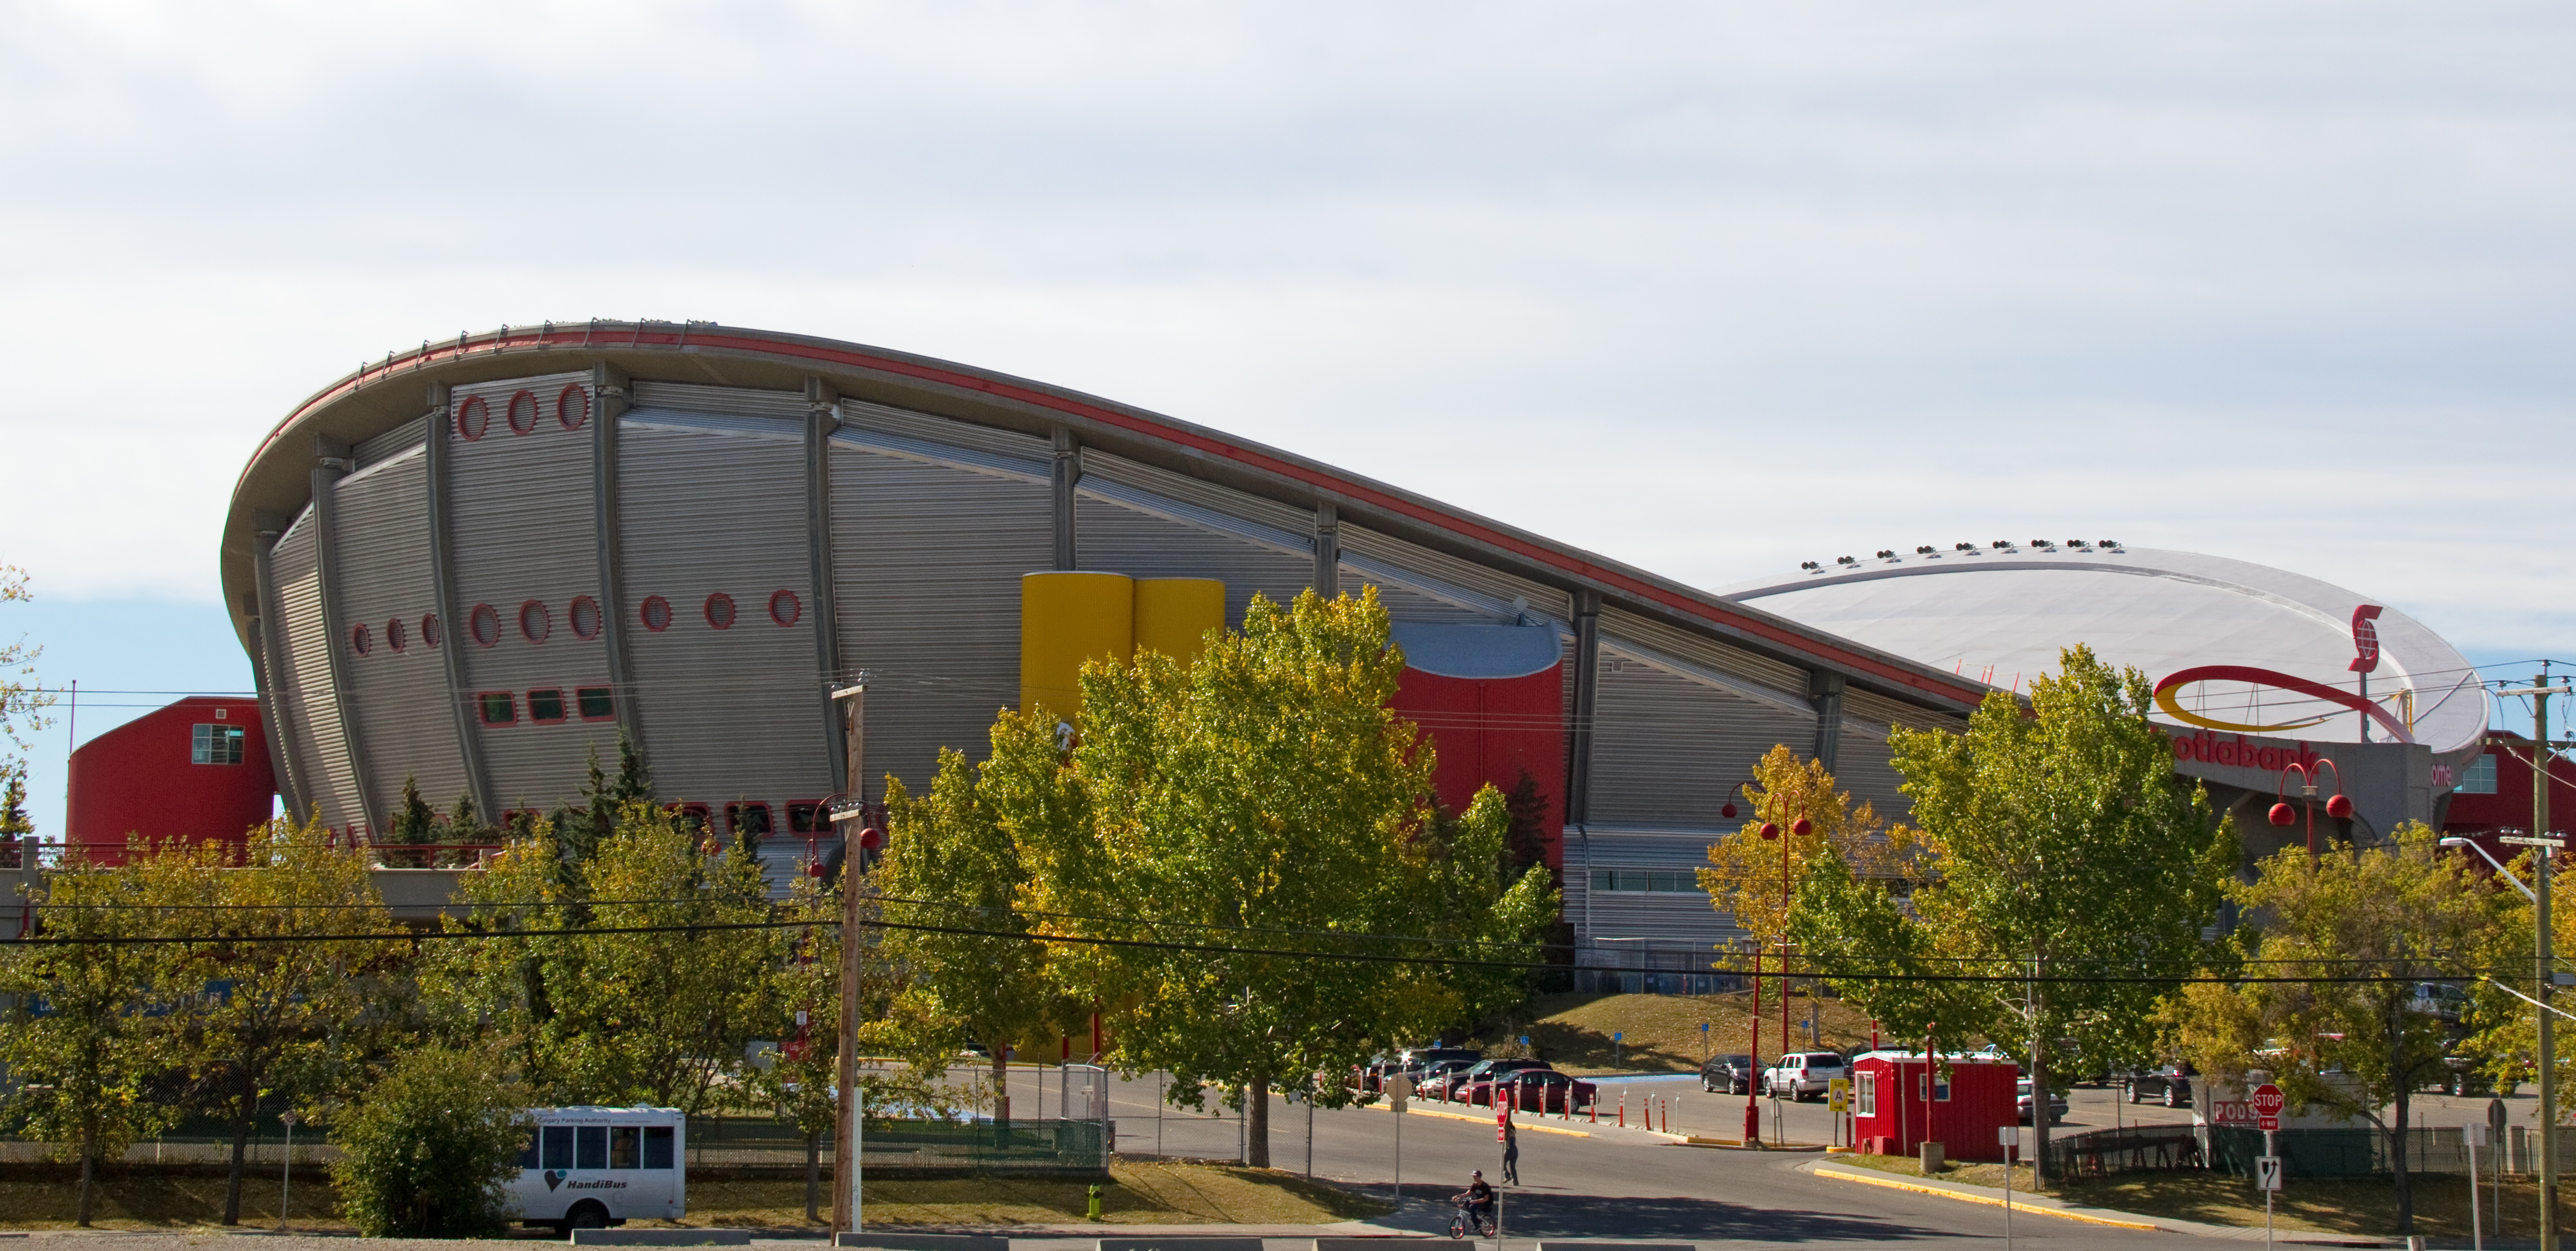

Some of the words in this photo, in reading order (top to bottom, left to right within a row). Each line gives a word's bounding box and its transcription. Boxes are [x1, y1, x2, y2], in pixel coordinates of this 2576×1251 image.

[2149, 725, 2320, 775] otiabank
[2432, 764, 2452, 787] ome
[1834, 1090, 1843, 1101] A
[2255, 1094, 2282, 1107] STOP
[1497, 1100, 1507, 1116] STOP
[2215, 1103, 2258, 1121] PODS
[567, 1180, 627, 1189] HandiBus
